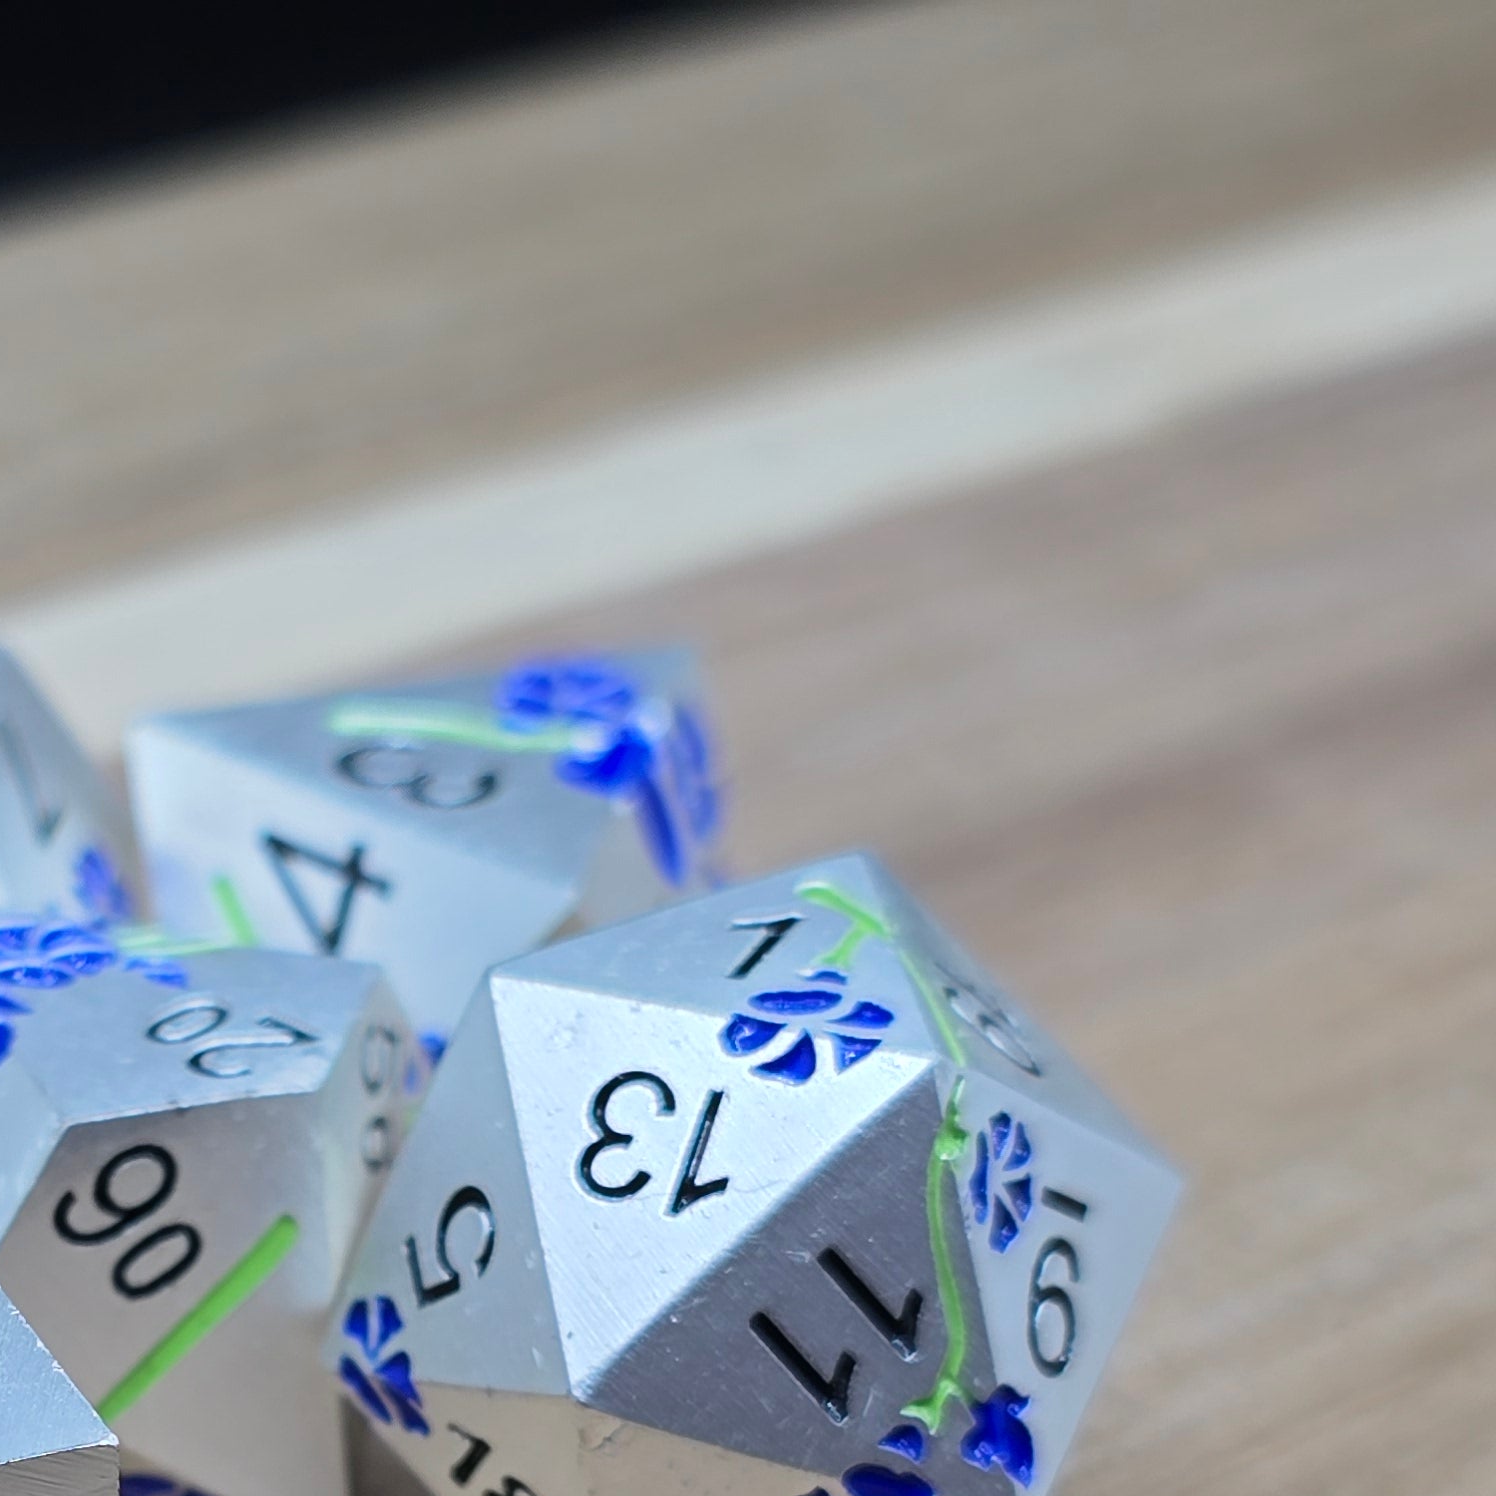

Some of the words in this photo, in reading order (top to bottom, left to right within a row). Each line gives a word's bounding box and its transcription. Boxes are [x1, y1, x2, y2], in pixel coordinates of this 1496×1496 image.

[261, 828, 393, 955] 4
[144, 1003, 319, 1080] 20
[576, 1071, 732, 1218] 13
[51, 1141, 203, 1303] 90
[405, 1183, 496, 1309] 5
[748, 1246, 925, 1427] 11
